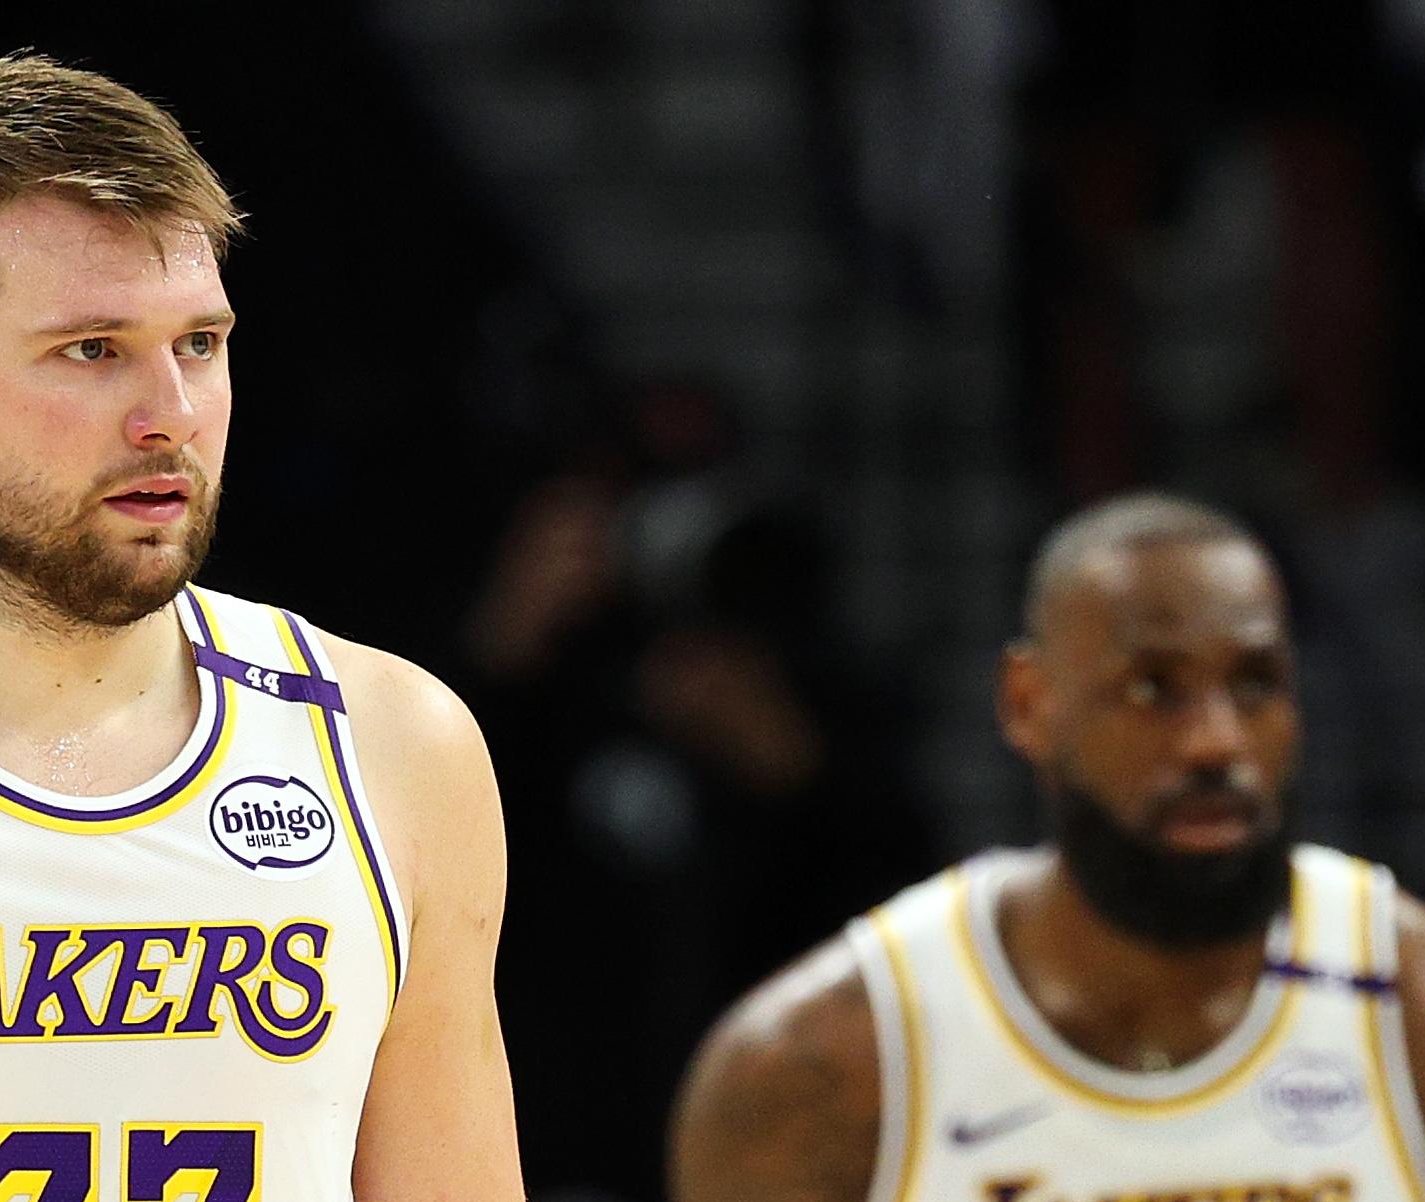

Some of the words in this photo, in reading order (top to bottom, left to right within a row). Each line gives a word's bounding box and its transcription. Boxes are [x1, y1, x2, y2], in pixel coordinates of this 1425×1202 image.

[245, 666, 280, 695] 44
[220, 800, 326, 840] bibigo
[246, 833, 292, 849] 비비고
